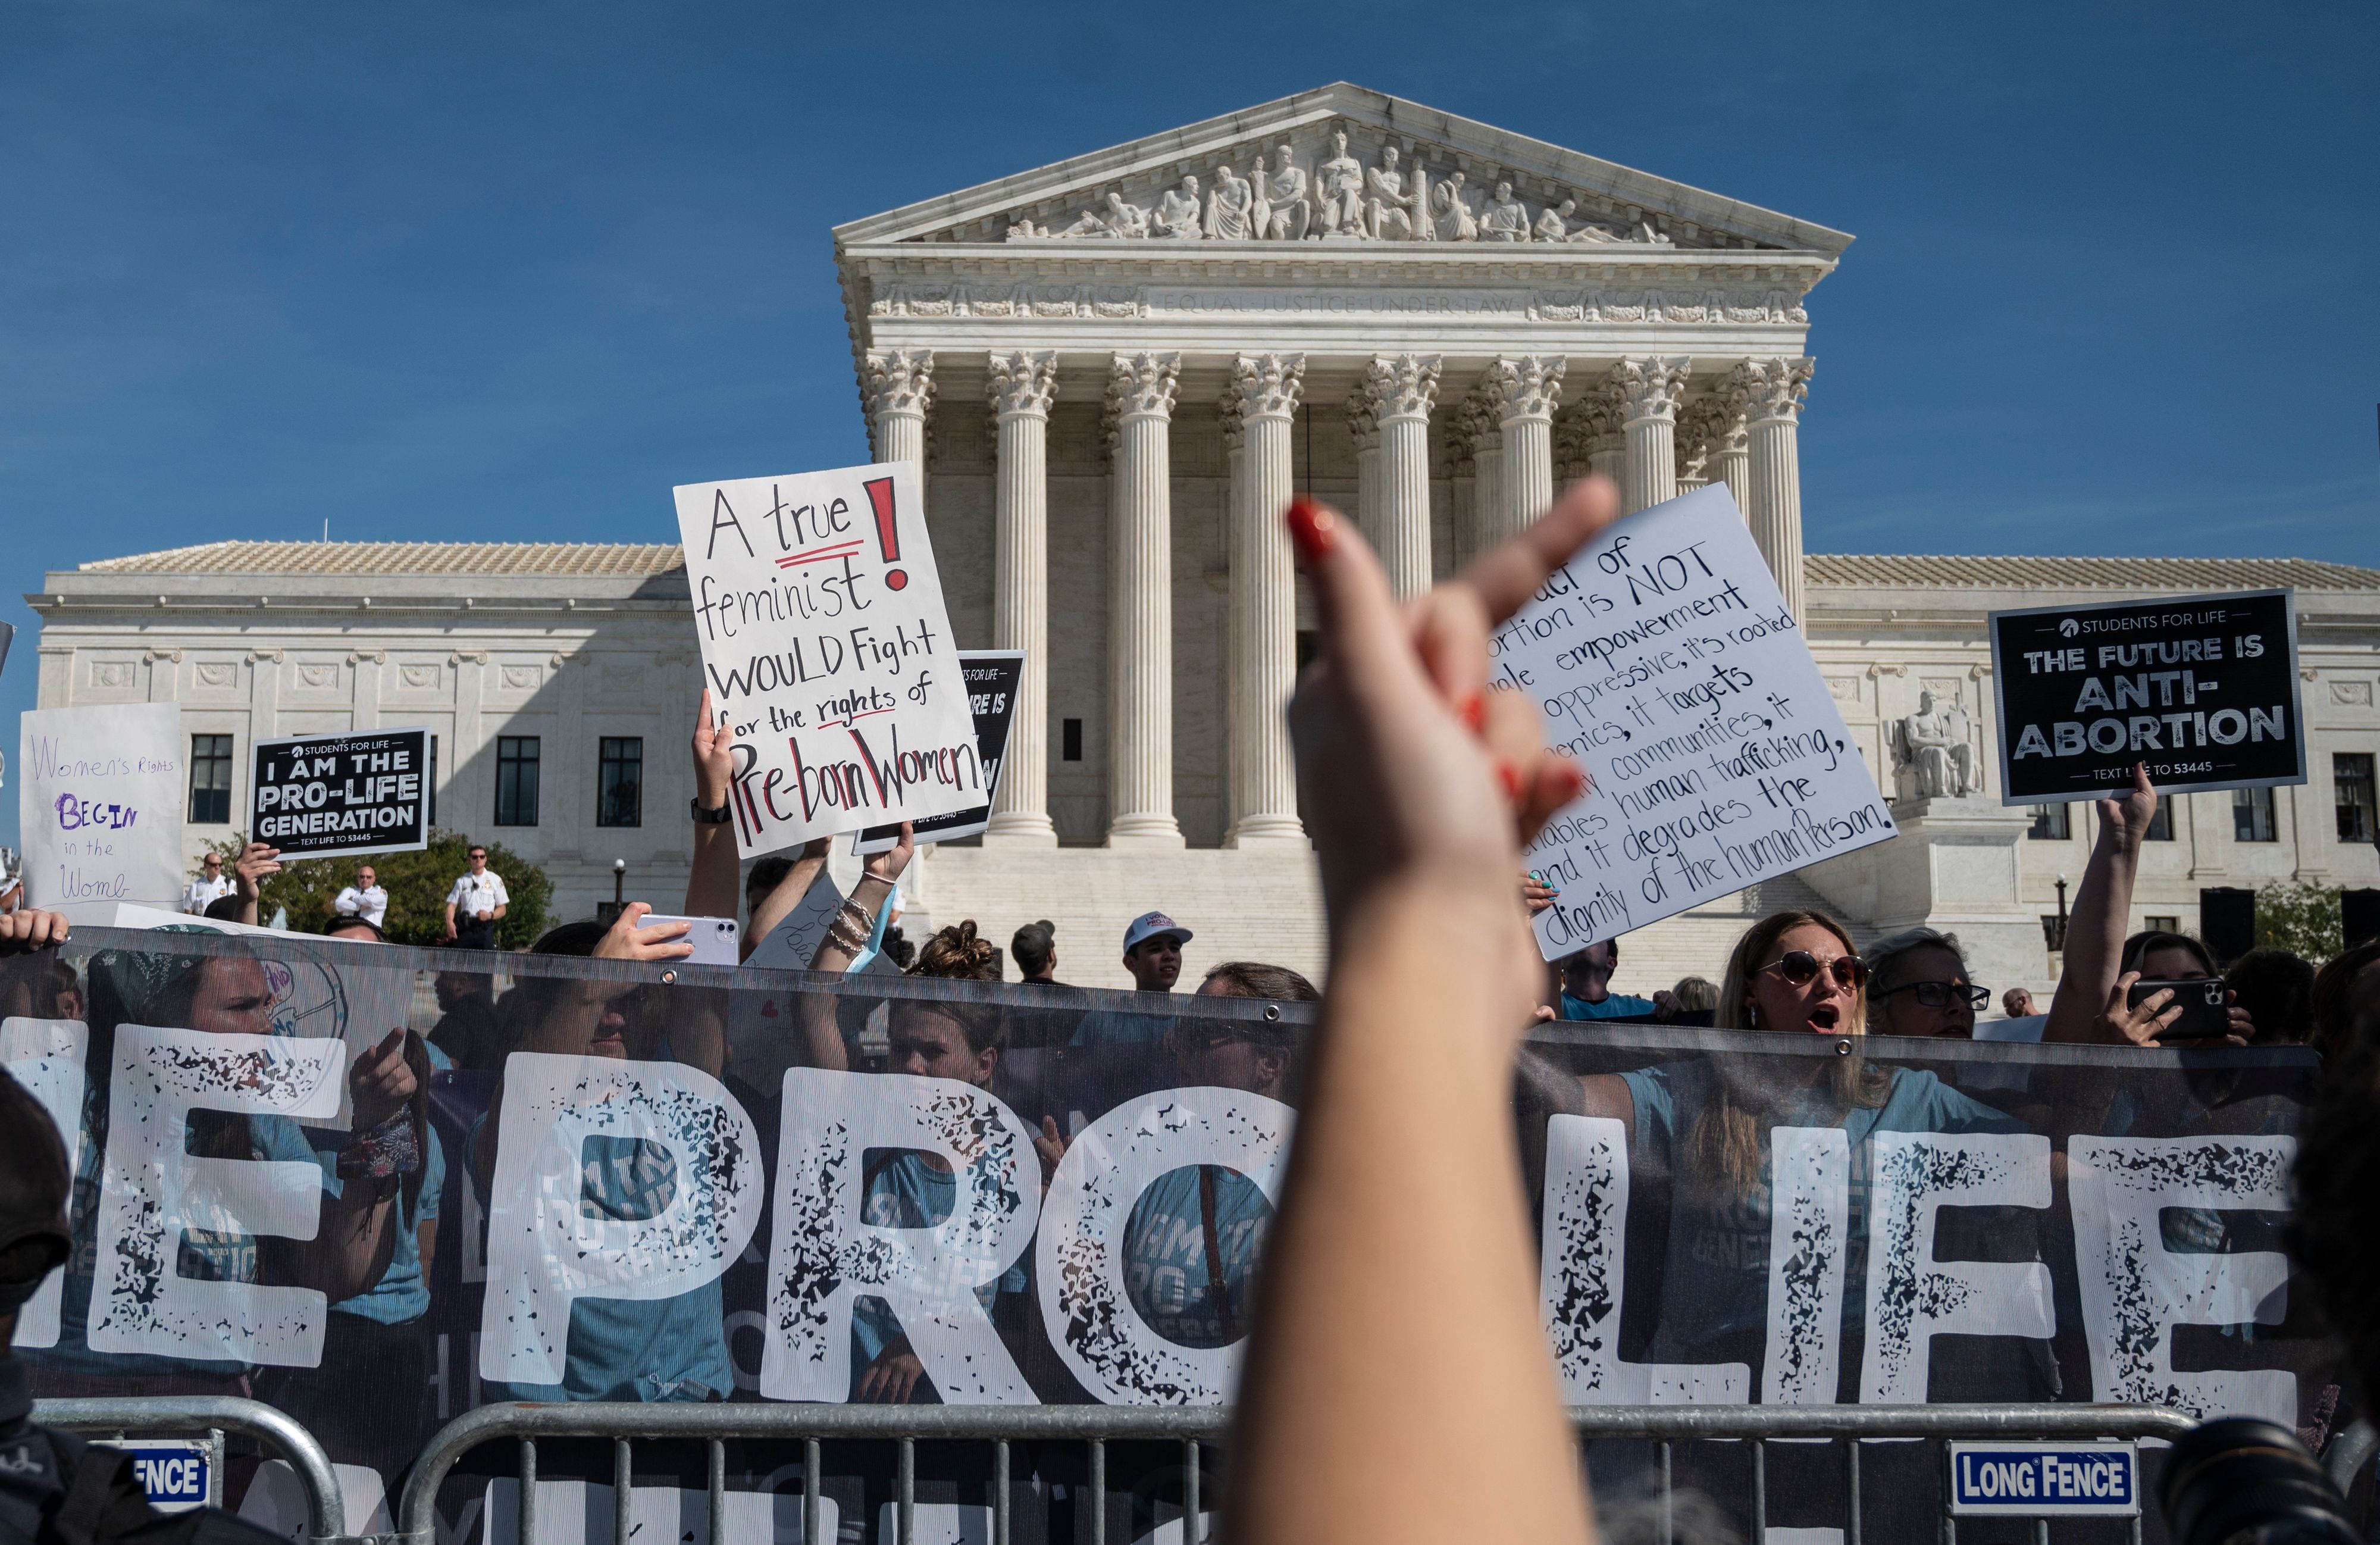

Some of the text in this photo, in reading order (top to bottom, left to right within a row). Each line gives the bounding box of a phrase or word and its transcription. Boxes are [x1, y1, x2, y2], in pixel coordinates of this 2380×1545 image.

[1164, 294, 1512, 314] EQUAL JUSTICE UNDER LAW
[707, 489, 754, 559] A
[762, 484, 851, 551] true
[1598, 536, 1631, 574] of
[697, 556, 872, 640] feminist
[1486, 540, 1714, 657] ortion is NOT
[1556, 579, 1749, 671] empowerment
[2082, 610, 2226, 634] STUDENTS FOR LIFE
[850, 619, 935, 675] Fight
[1544, 605, 1797, 728] oppressive, it's rooted
[2024, 634, 2264, 674] THE FUTURE IS
[970, 669, 985, 680] FOR
[985, 668, 998, 680] LIFE
[1626, 687, 1655, 726] it
[1656, 664, 1753, 715] targets
[2074, 670, 2218, 713] ANTI-
[769, 706, 806, 732] the
[816, 689, 895, 727] rights
[908, 671, 932, 705] of
[992, 692, 1006, 714] IS
[305, 740, 389, 755] STUDENTS FOR LIFE
[1611, 692, 1793, 780] communities, it
[2013, 705, 2285, 760] ABORTION
[31, 734, 130, 780] Women's
[268, 750, 409, 781] I AM THE
[1612, 769, 1706, 820] human
[1708, 728, 1845, 783] trafficking,
[2093, 761, 2212, 780] TEXT LE TO 53445
[54, 792, 138, 830] BEGIN
[258, 774, 419, 812] PRO-LIFE
[260, 805, 414, 837] GENERATION
[348, 833, 371, 842] 53445
[1585, 839, 1611, 870] it
[1624, 799, 1751, 861] degrades
[1757, 775, 1816, 809] the
[65, 838, 114, 856] in the
[61, 864, 130, 899] Womb
[1546, 883, 1631, 945] dignity
[1642, 856, 1669, 903] of
[1674, 851, 1724, 892] the
[1540, 1113, 2298, 1425] LIFE
[2041, 1455, 2125, 1497] FENCE
